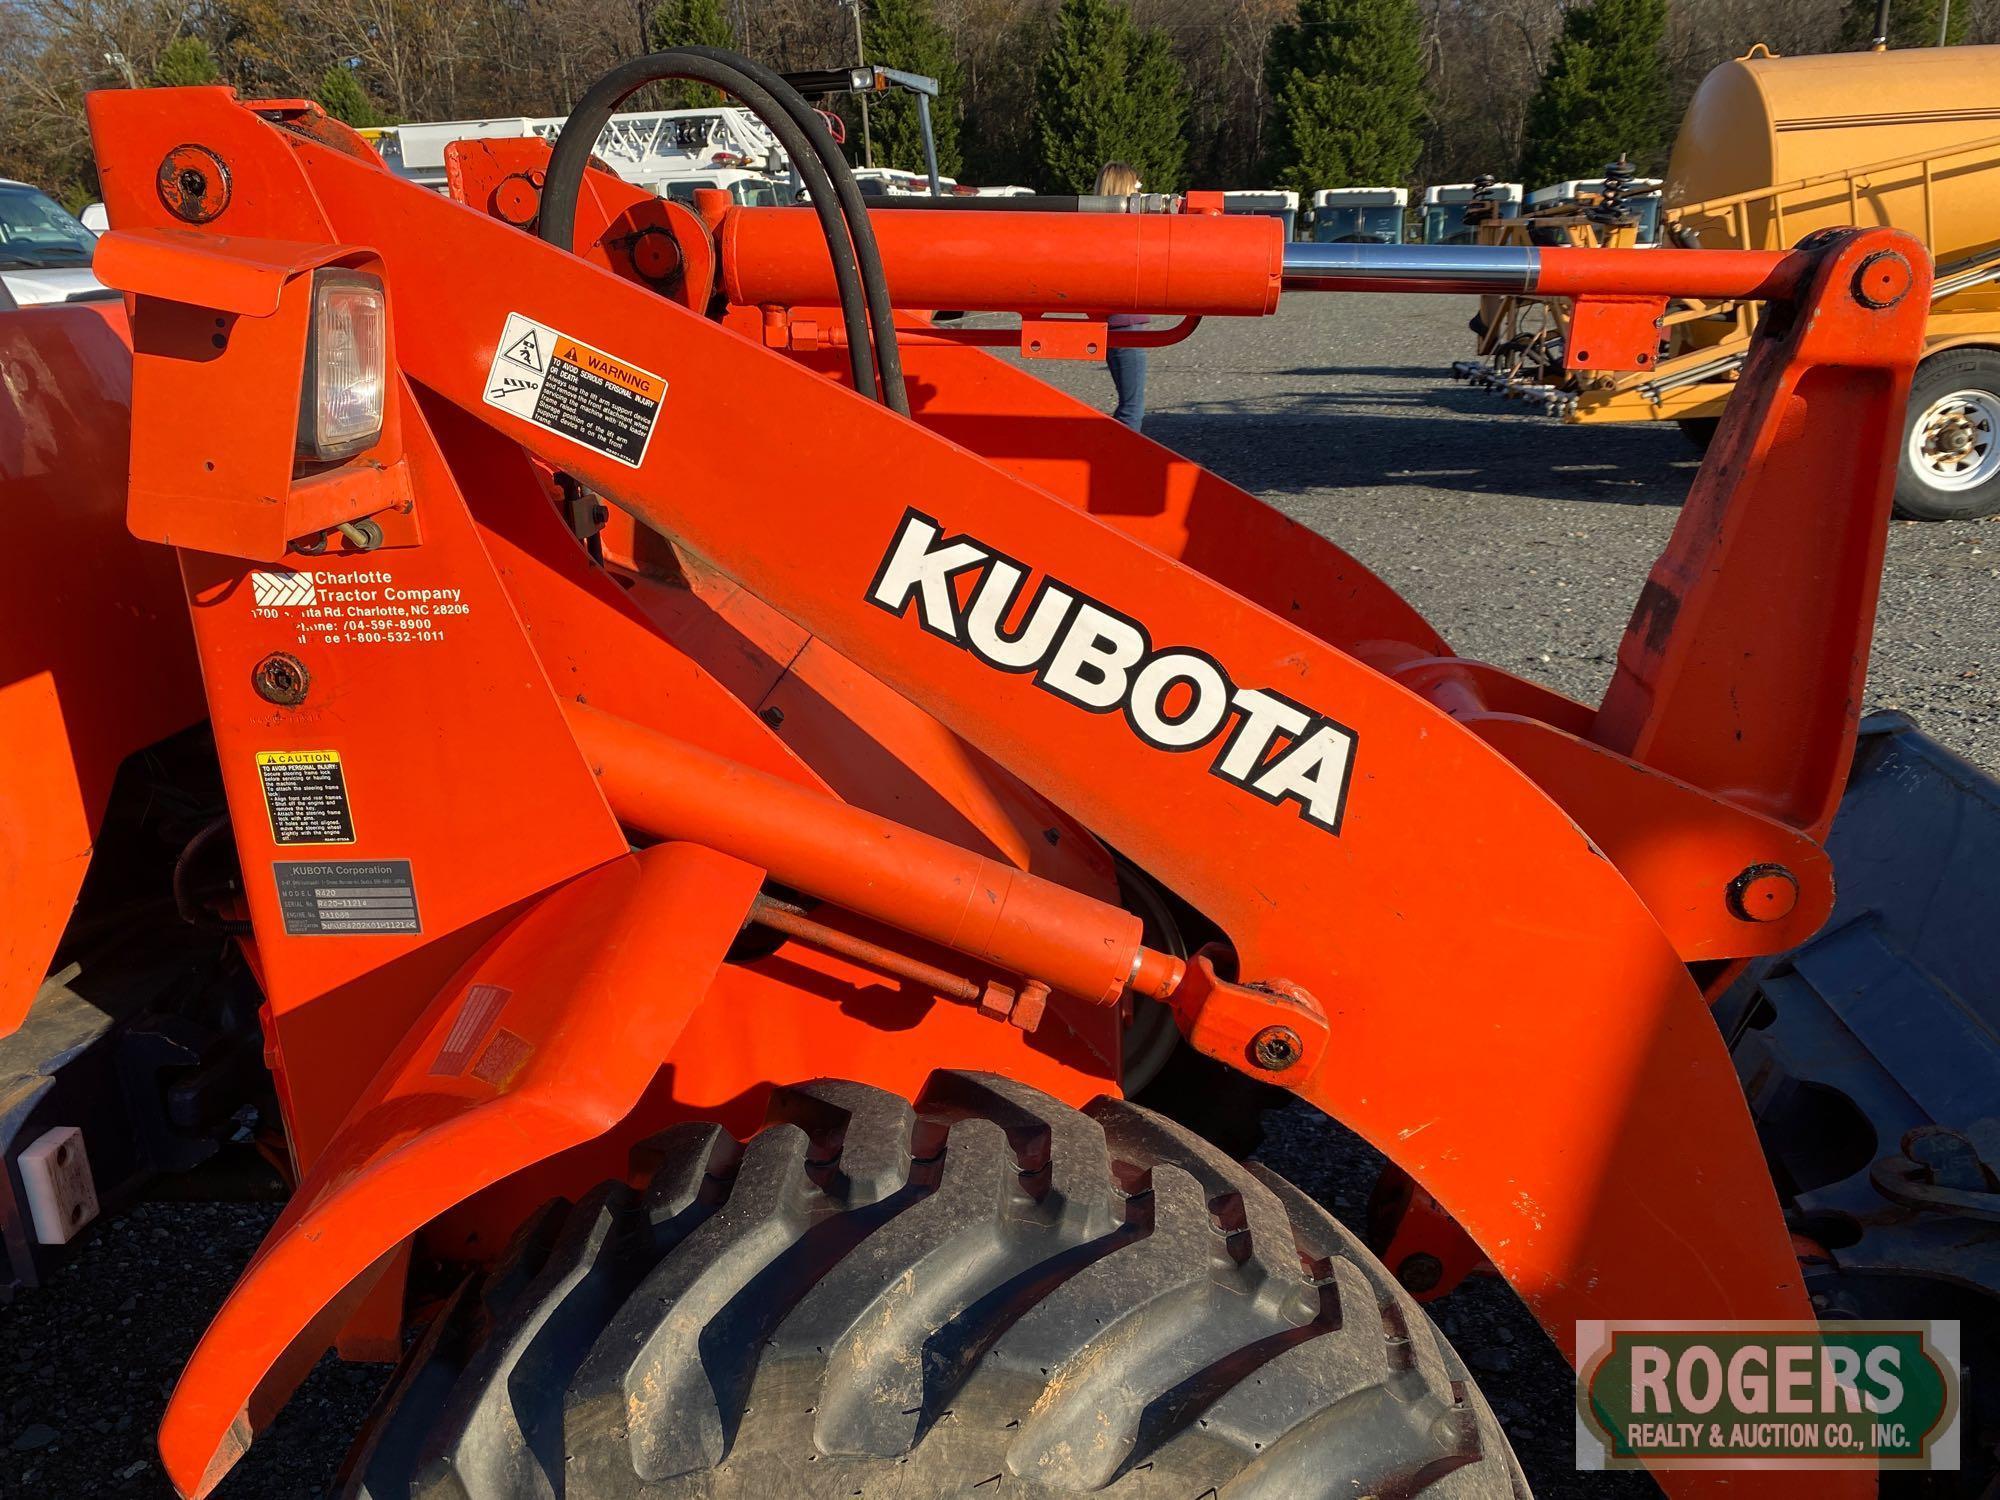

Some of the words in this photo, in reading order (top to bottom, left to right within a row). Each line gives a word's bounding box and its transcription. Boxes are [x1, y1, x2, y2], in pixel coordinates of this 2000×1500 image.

[549, 366, 558, 375] OR
[552, 358, 561, 366] TO
[562, 362, 579, 374] AVOID
[579, 370, 603, 385] SERIOUS
[604, 381, 633, 399] PERSONAL
[634, 394, 654, 408] INJURY
[586, 355, 651, 392] WARNING
[540, 393, 558, 405] frame
[544, 380, 556, 390] and
[556, 387, 577, 399] remove
[577, 395, 587, 404] the
[587, 400, 601, 410] front
[602, 406, 633, 424] attachment
[633, 420, 649, 431] when
[547, 374, 567, 388] Always
[568, 384, 578, 392] use
[579, 388, 589, 397] the
[598, 398, 610, 406] arm
[611, 402, 632, 417] support
[633, 412, 651, 424] device
[538, 400, 561, 415] Storage
[562, 410, 584, 426] position
[586, 421, 593, 429] of
[594, 425, 605, 434] the
[606, 430, 614, 438] lift
[616, 436, 628, 445] arm
[542, 387, 567, 404] servicing
[568, 399, 578, 407] the
[579, 403, 603, 418] machine
[604, 414, 617, 424] with
[617, 420, 628, 429] the
[629, 426, 646, 438] loader
[536, 406, 558, 422] support
[560, 416, 578, 429] device
[579, 425, 585, 433] is
[596, 433, 607, 443] the
[608, 439, 623, 450] front
[315, 571, 392, 585] Charlotte
[317, 589, 377, 602] Tractor
[384, 588, 461, 602] Company
[324, 607, 343, 617] Rd.
[348, 606, 409, 617] Charlotte,
[411, 605, 429, 615] NC
[433, 604, 470, 614] 28206
[344, 631, 445, 643] 1-800-532-1011
[870, 511, 1355, 831] KUBOTA
[278, 754, 331, 762] CAUTION
[292, 866, 334, 875] KUBOTA
[335, 865, 392, 875] Corporation
